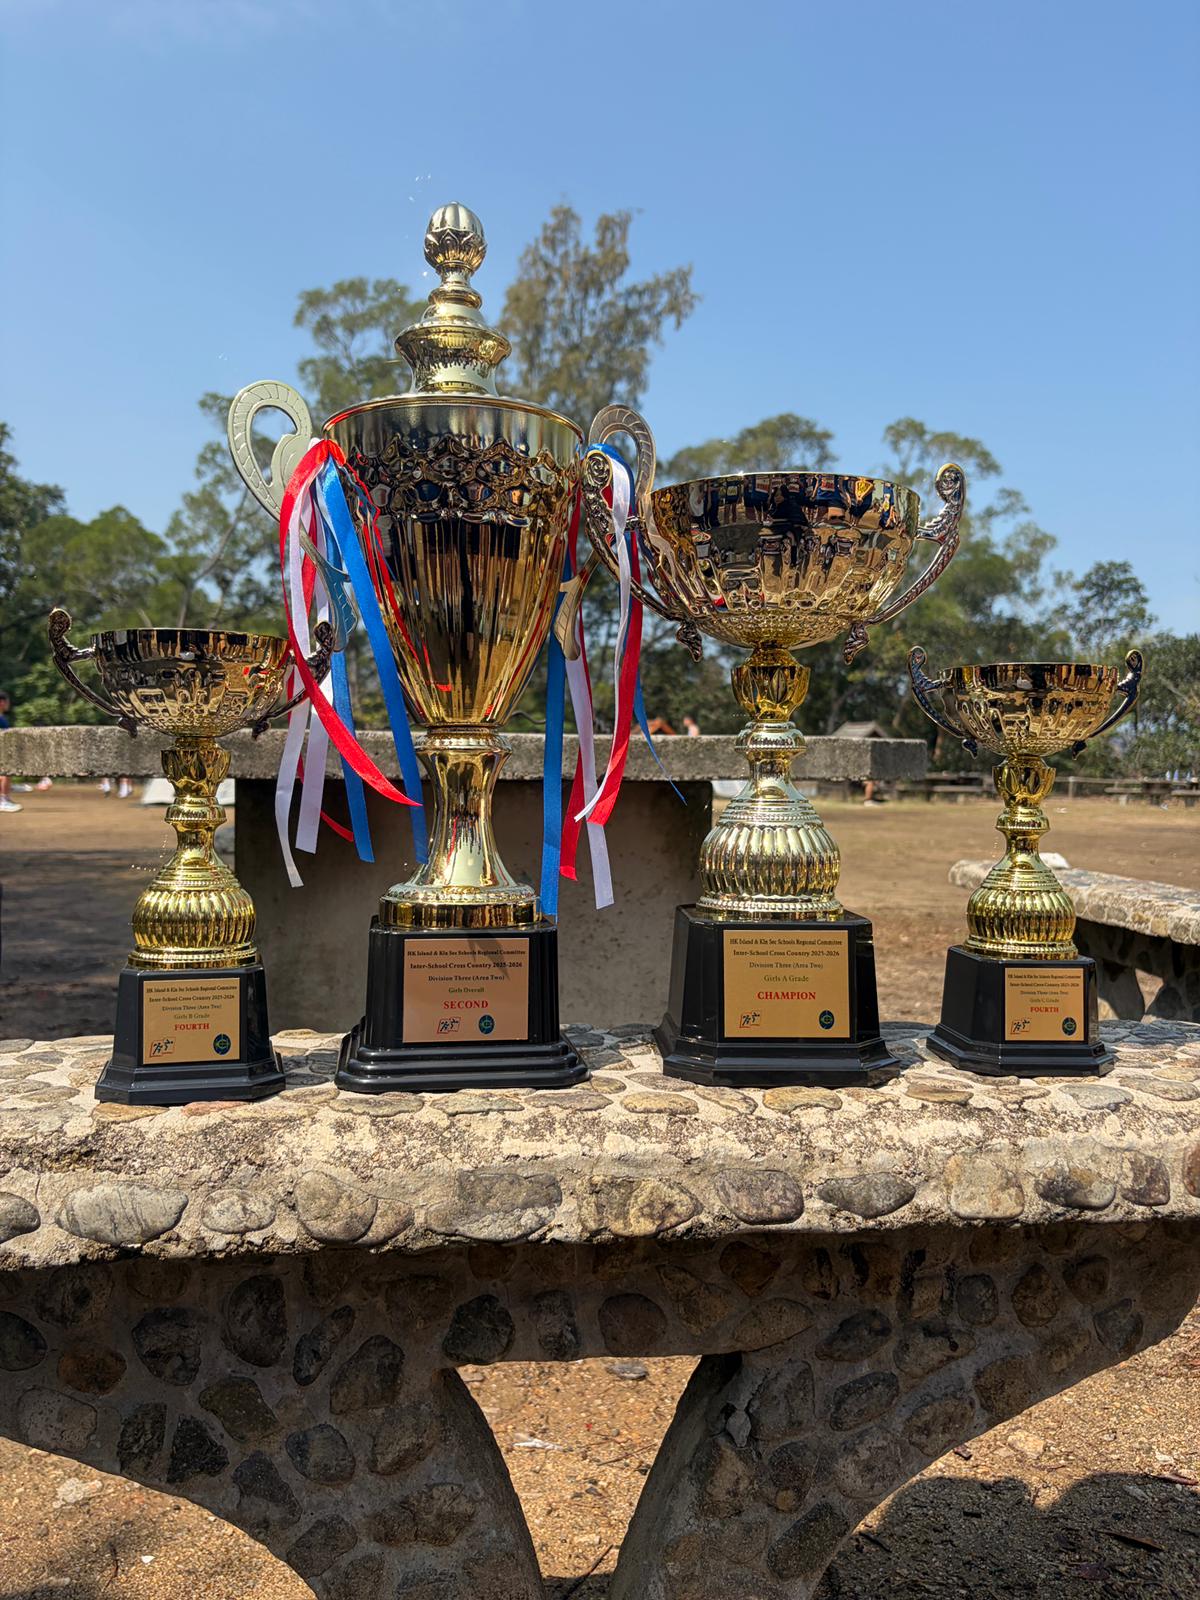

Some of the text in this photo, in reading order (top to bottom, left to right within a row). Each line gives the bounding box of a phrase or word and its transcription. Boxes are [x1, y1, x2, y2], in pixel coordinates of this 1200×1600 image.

[757, 992, 816, 1000] CHAMPION
[443, 1000, 489, 1009] SECOND
[174, 1023, 209, 1031] FOURTH
